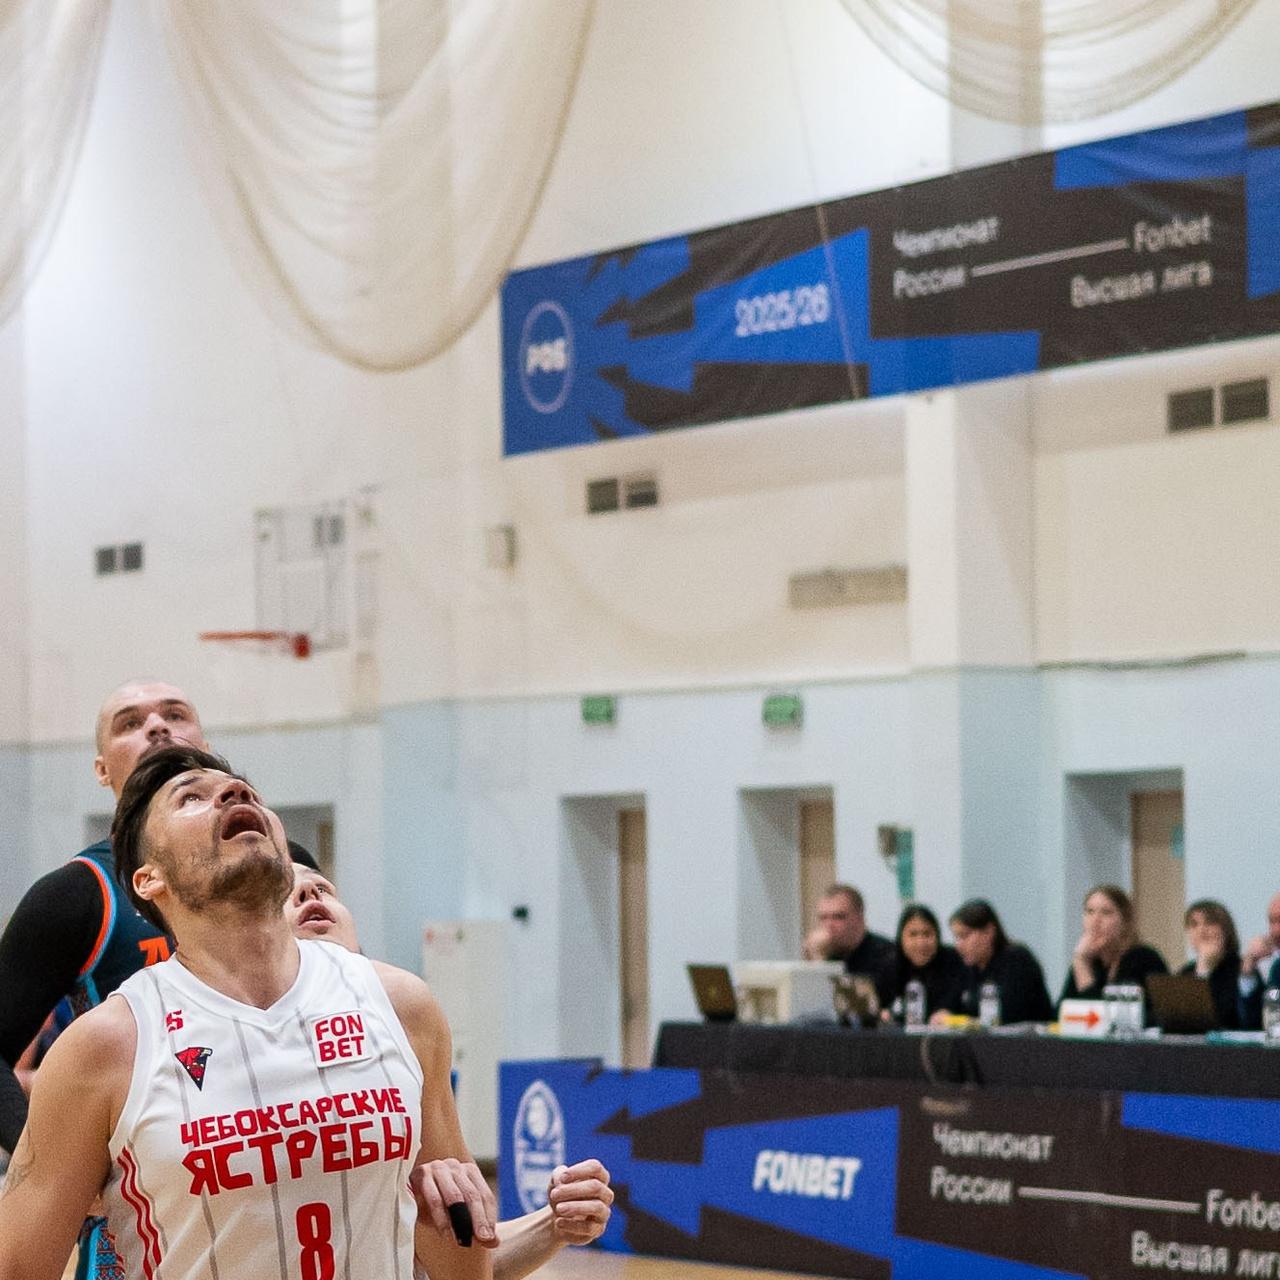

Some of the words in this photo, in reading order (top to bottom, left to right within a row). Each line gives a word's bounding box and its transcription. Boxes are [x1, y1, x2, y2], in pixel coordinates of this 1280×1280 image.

[1133, 215, 1211, 252] Fonbet
[735, 282, 830, 338] 2025/26
[315, 1013, 364, 1041] FON
[318, 1035, 365, 1062] BET
[180, 1087, 407, 1148] ЧЕБОКСАРСКИЕ
[932, 1121, 1056, 1162] Чемпионат
[182, 1116, 412, 1196] ЯСТРЕБЫ
[753, 1149, 862, 1200] FONBET
[930, 1165, 1013, 1205] России
[1206, 1188, 1280, 1232] Fonbe
[1131, 1229, 1230, 1275] Высшая
[1235, 1248, 1280, 1279] лиг
